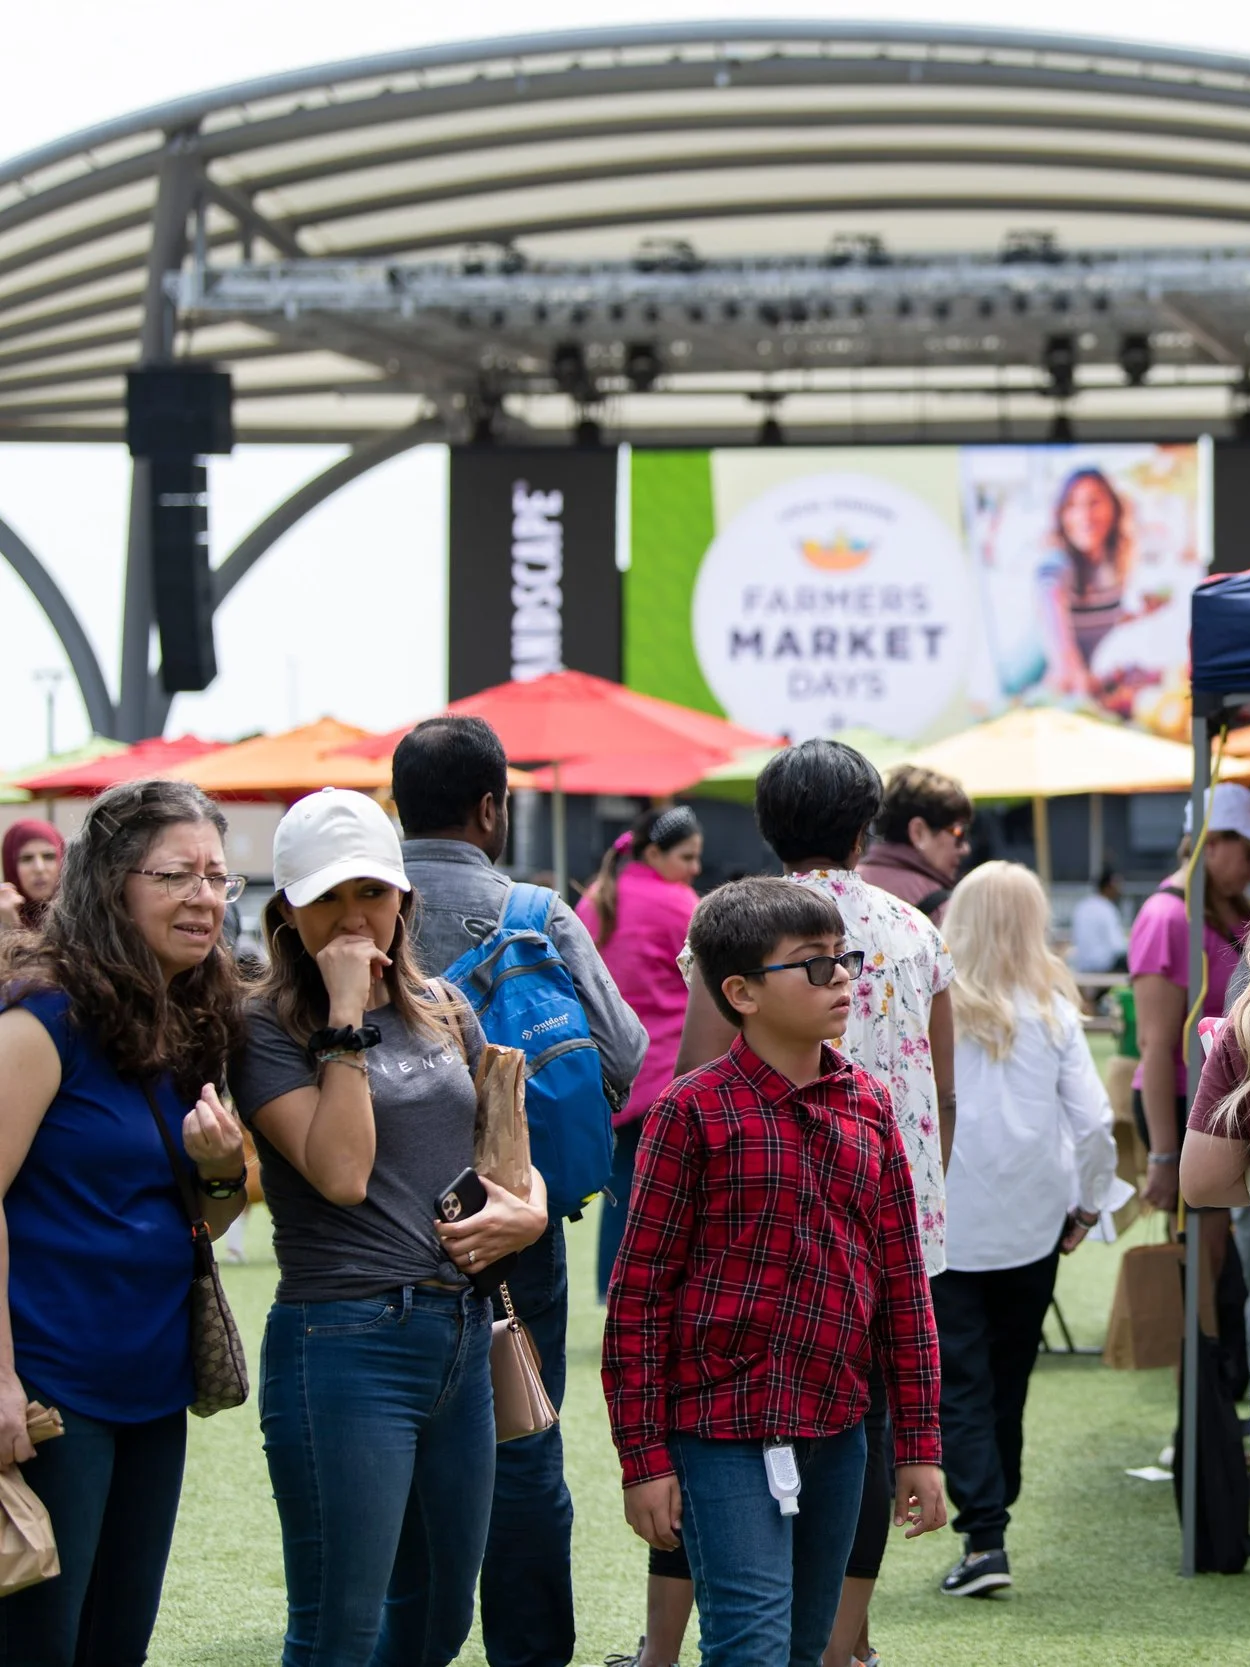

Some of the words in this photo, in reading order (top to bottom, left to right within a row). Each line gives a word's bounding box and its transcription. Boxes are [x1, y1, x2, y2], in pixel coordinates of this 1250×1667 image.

[742, 584, 930, 615] FARMERS
[729, 626, 947, 660] MARKET
[787, 669, 886, 700] DAYS
[533, 1012, 569, 1032] Outdoor
[380, 1053, 455, 1074] IEND
